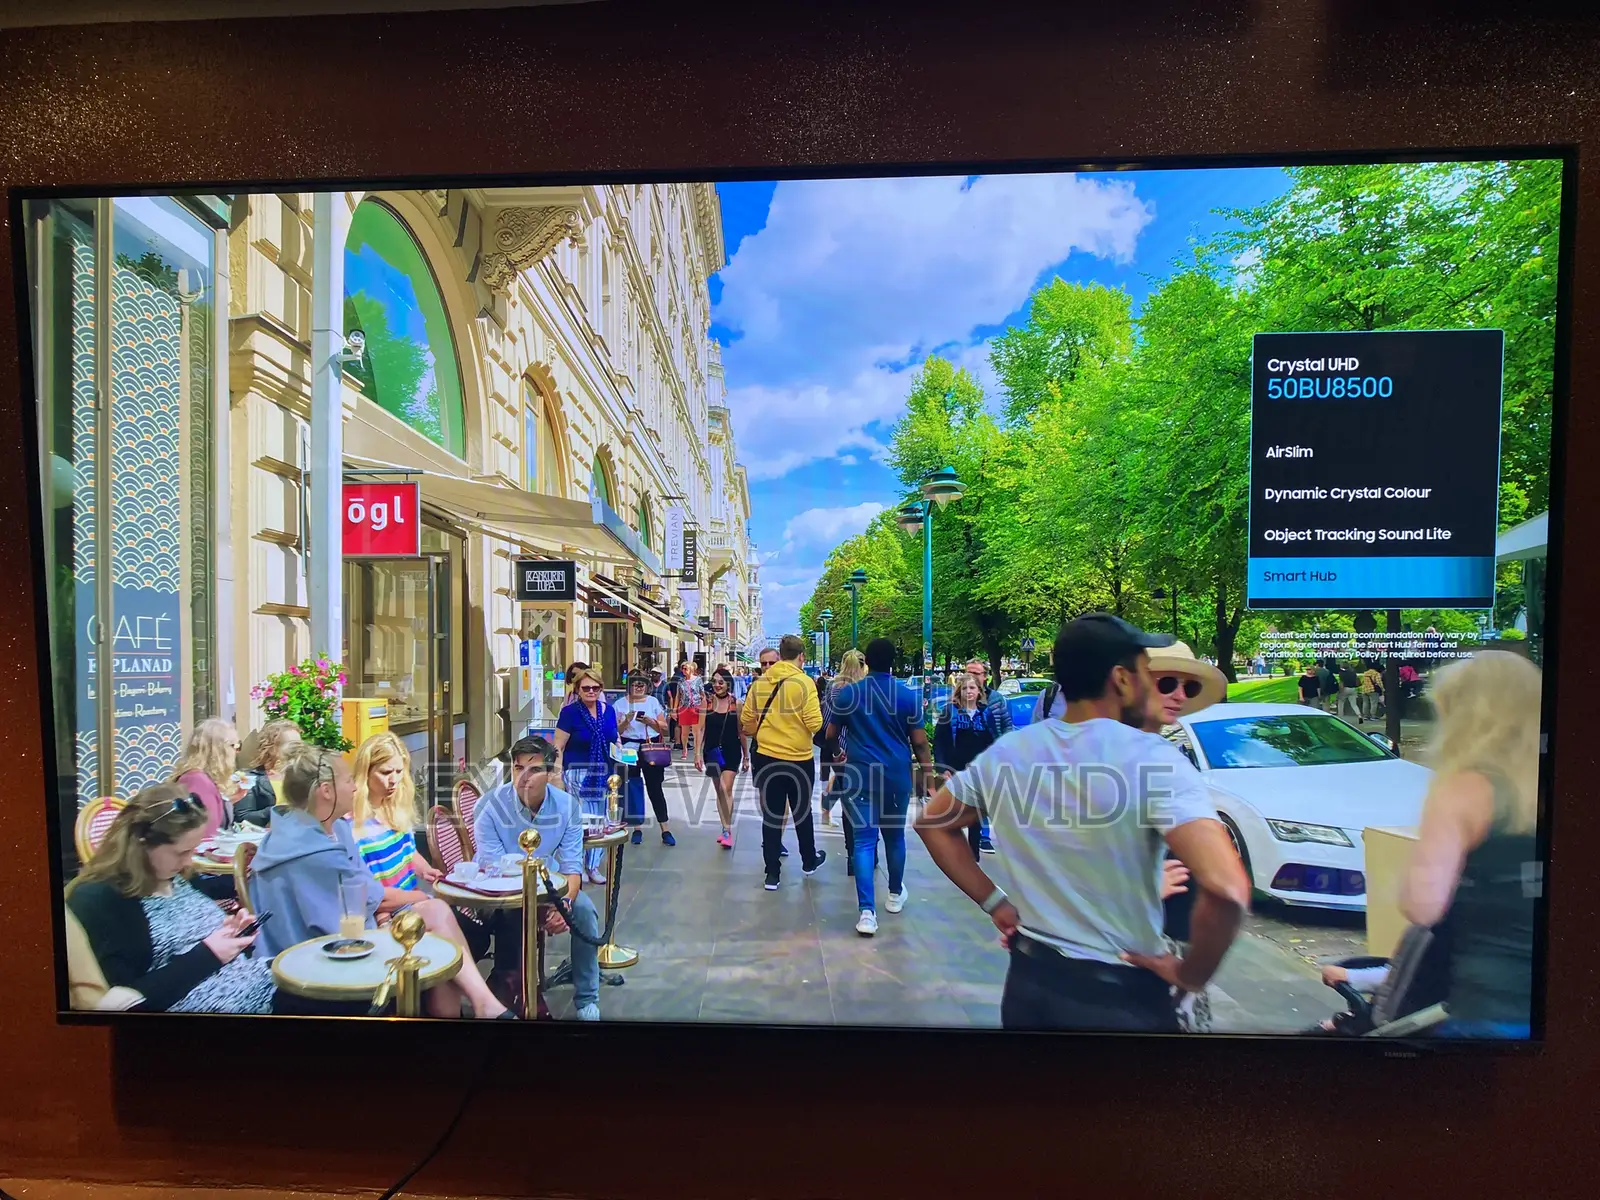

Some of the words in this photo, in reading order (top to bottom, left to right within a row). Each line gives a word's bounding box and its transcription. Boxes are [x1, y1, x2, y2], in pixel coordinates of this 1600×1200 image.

[1267, 357, 1325, 375] Crystal
[1328, 357, 1360, 371] UHD
[1267, 376, 1393, 399] 50BU8500
[1265, 444, 1314, 459] AirSlim
[1264, 486, 1328, 503] Dynamic
[1330, 486, 1382, 503] Crystal
[1384, 486, 1432, 499] Colour
[670, 512, 679, 562] TREVIAN
[1263, 527, 1312, 544] Object
[1314, 527, 1376, 544] Tracking
[1378, 527, 1424, 541] Sound
[1426, 526, 1452, 540] Lite
[685, 535, 694, 577] Siluetti
[1263, 569, 1307, 582] Smart
[1310, 569, 1337, 582] Hub
[1259, 631, 1293, 639] Content
[1295, 631, 1330, 639] services
[1331, 631, 1348, 639] and
[1350, 631, 1423, 639] recommendation
[1424, 632, 1444, 641] may
[1446, 632, 1466, 641] vary
[1467, 631, 1478, 641] by
[1293, 641, 1340, 651] Agreement
[1341, 641, 1350, 649] of
[1352, 641, 1366, 649] the
[1367, 641, 1394, 649] Smart
[1395, 641, 1411, 649] Hub
[1413, 641, 1439, 649] Terms
[1440, 641, 1458, 649] and
[1323, 651, 1354, 660] Privacy
[1355, 651, 1380, 660] Policy
[1389, 651, 1426, 660] required
[87, 658, 172, 674] EPLANAD
